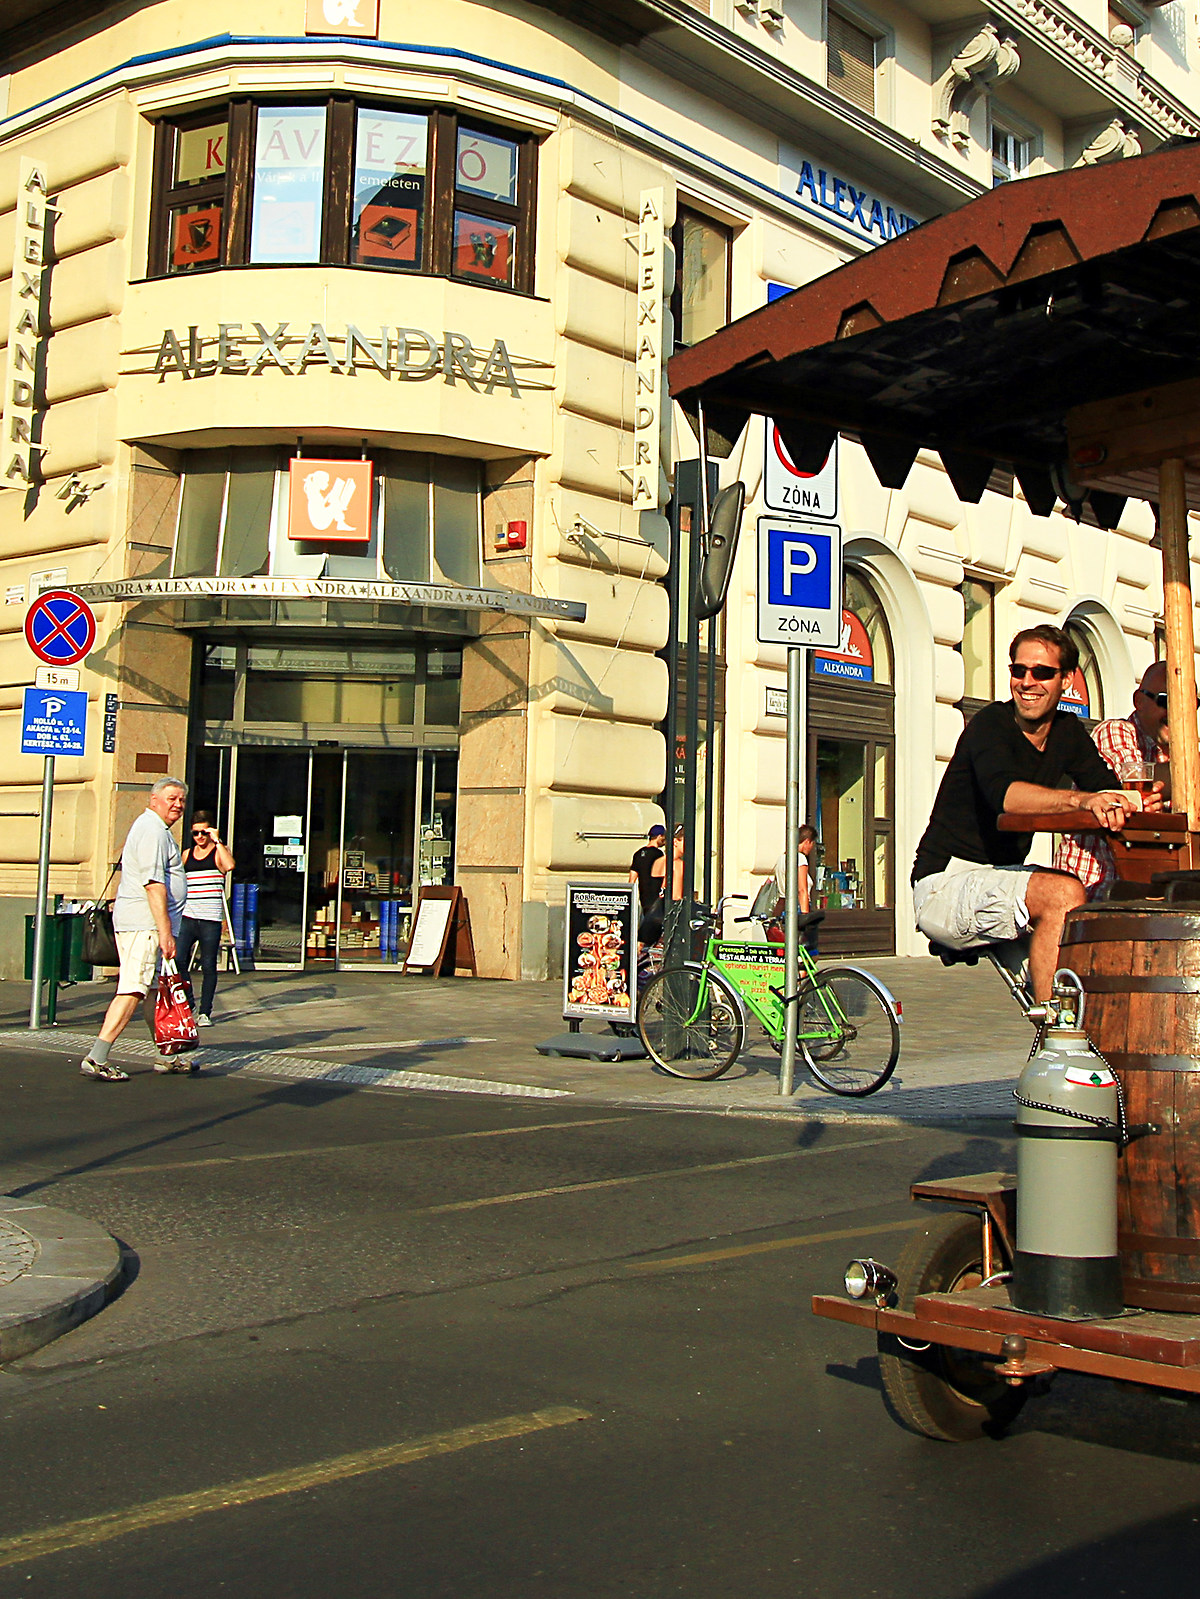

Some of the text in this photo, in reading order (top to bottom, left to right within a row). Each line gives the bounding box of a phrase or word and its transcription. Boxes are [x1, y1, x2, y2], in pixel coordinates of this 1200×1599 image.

[359, 174, 420, 190] emeleten
[6, 167, 47, 481] ALEXANDRA
[154, 322, 519, 388] ALEXANDRA
[633, 197, 659, 500] ALEXANDRA
[782, 484, 821, 509] ZÓNA
[783, 540, 817, 596] P
[154, 577, 247, 594] ALEXANDRA
[260, 578, 358, 597] ALEXANDRA
[369, 582, 469, 603] ALEXANDRA
[778, 615, 821, 634] ZÓNA
[47, 673, 58, 684] 15
[823, 662, 863, 678] ALEXANDRA
[46, 702, 62, 718] P
[719, 953, 758, 962] RESTAURANT
